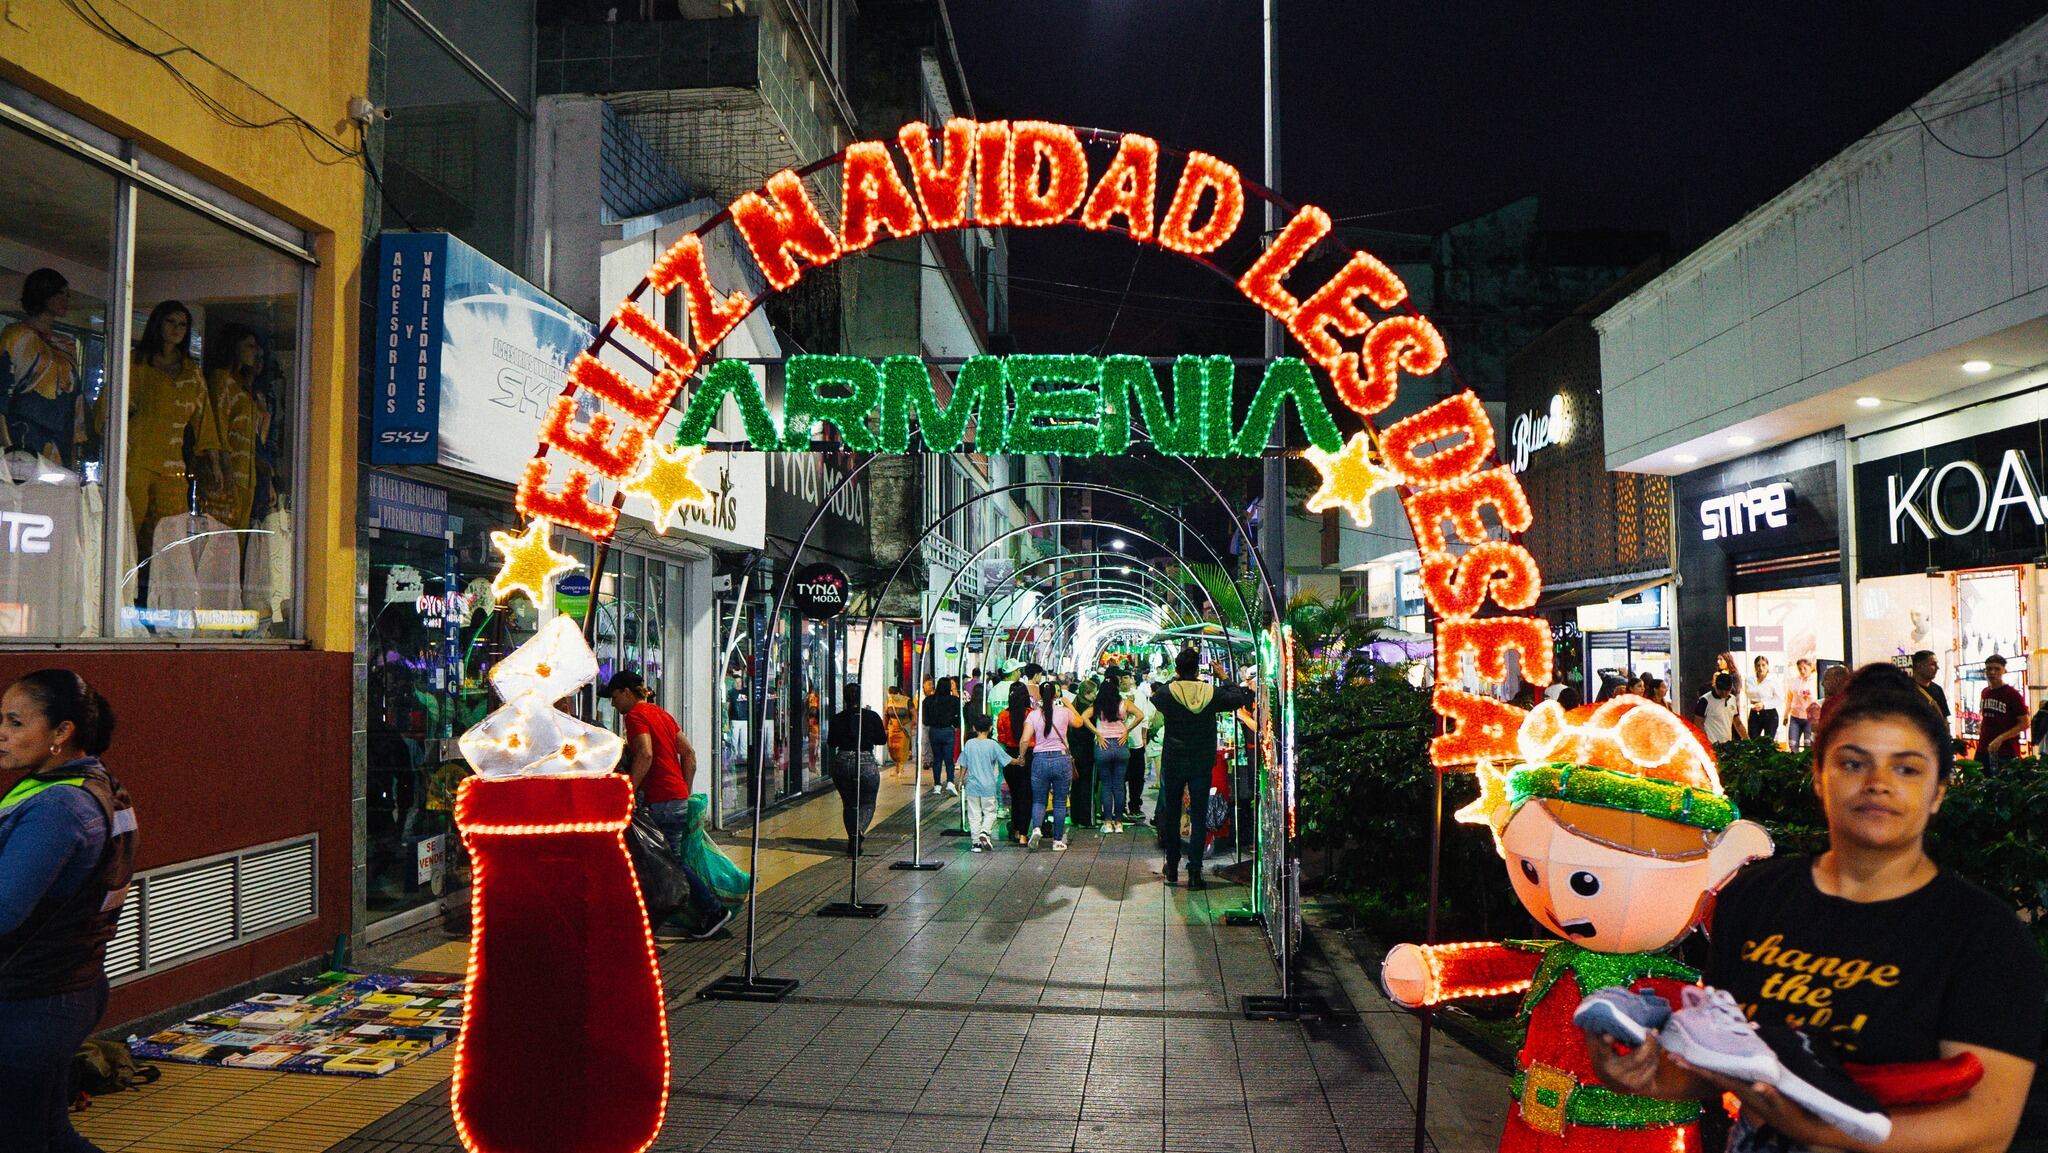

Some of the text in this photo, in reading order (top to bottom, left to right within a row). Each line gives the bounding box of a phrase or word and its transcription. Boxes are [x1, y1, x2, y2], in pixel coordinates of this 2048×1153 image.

[387, 252, 433, 413] ACCESORIOS Y VARIEDADES
[676, 353, 1343, 458] ARMENIA
[380, 432, 430, 443] SKY
[515, 117, 1554, 767] FELIZ NAVIDAD LES DESEA
[797, 583, 838, 595] TYNA
[812, 595, 841, 603] MODA
[420, 851, 444, 869] VENDE
[426, 841, 436, 853] SE
[1741, 934, 1900, 989] change
[1760, 973, 1833, 1008] the
